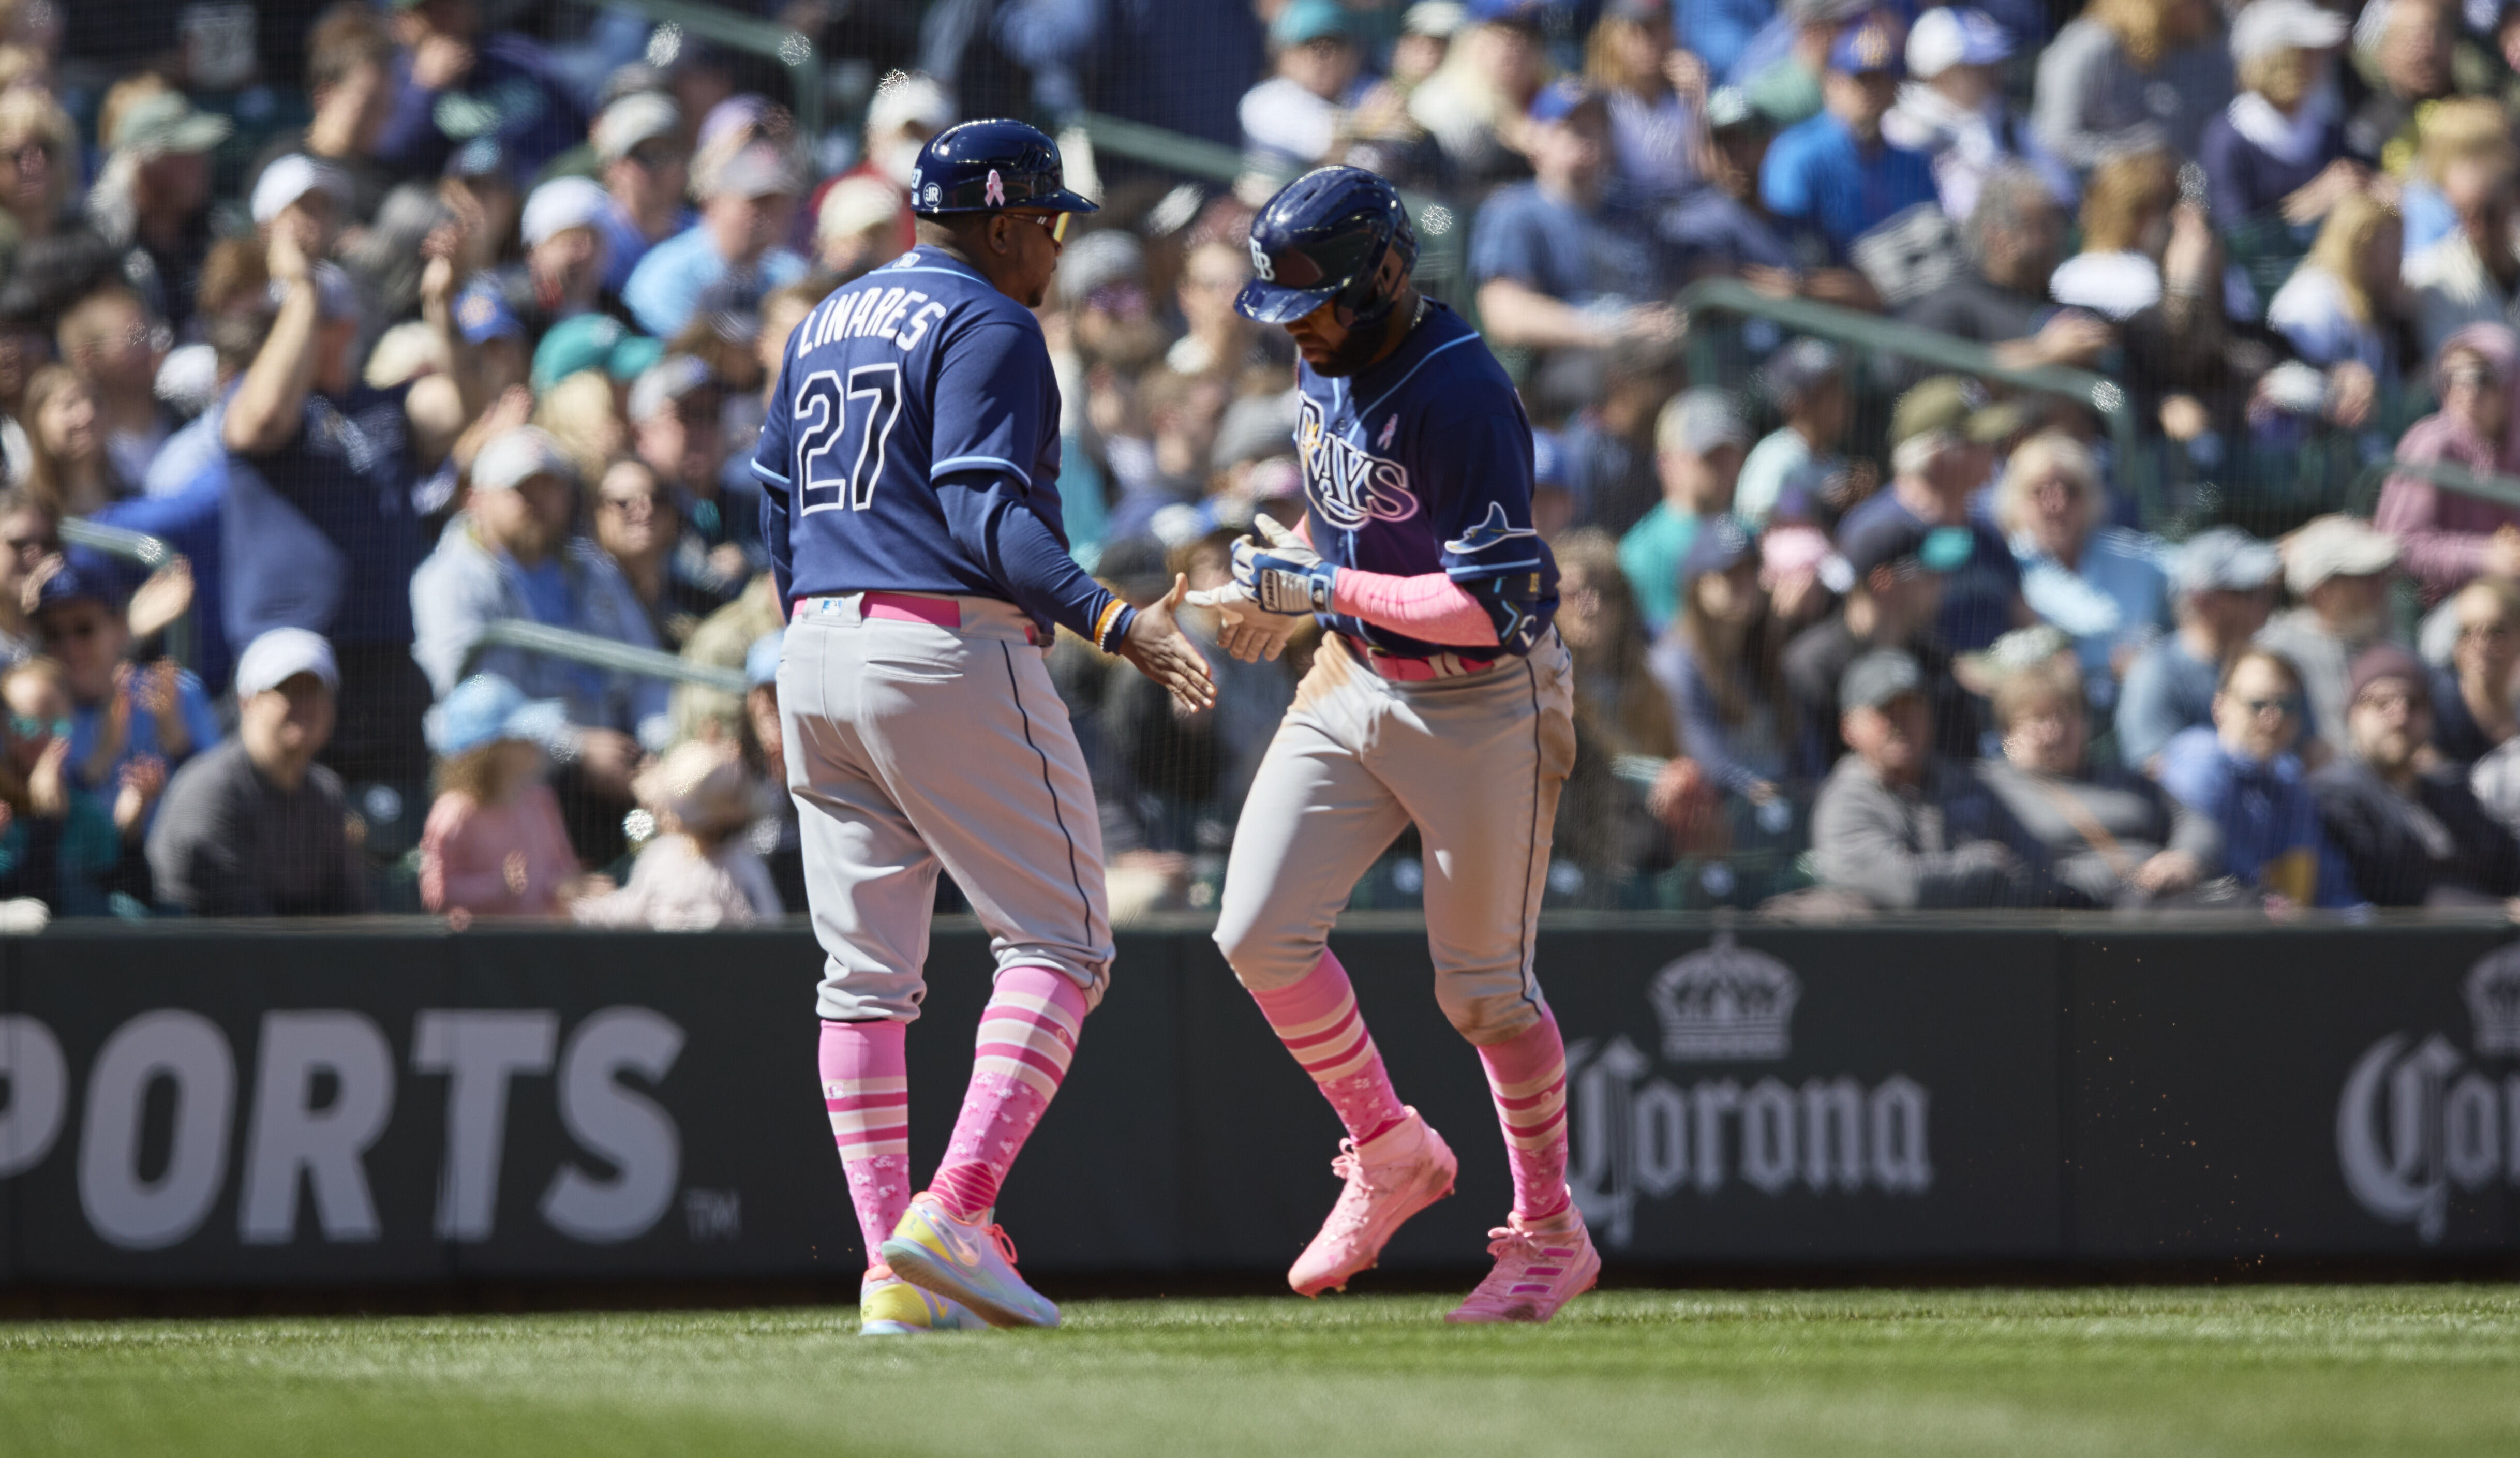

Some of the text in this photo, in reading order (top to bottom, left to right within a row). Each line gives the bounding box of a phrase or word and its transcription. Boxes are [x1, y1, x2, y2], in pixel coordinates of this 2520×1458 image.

[798, 287, 947, 359] LINARES
[1248, 236, 1276, 281] TB
[795, 363, 902, 516] 27
[1565, 1035, 1933, 1247] Corona
[2336, 1034, 2520, 1243] Co
